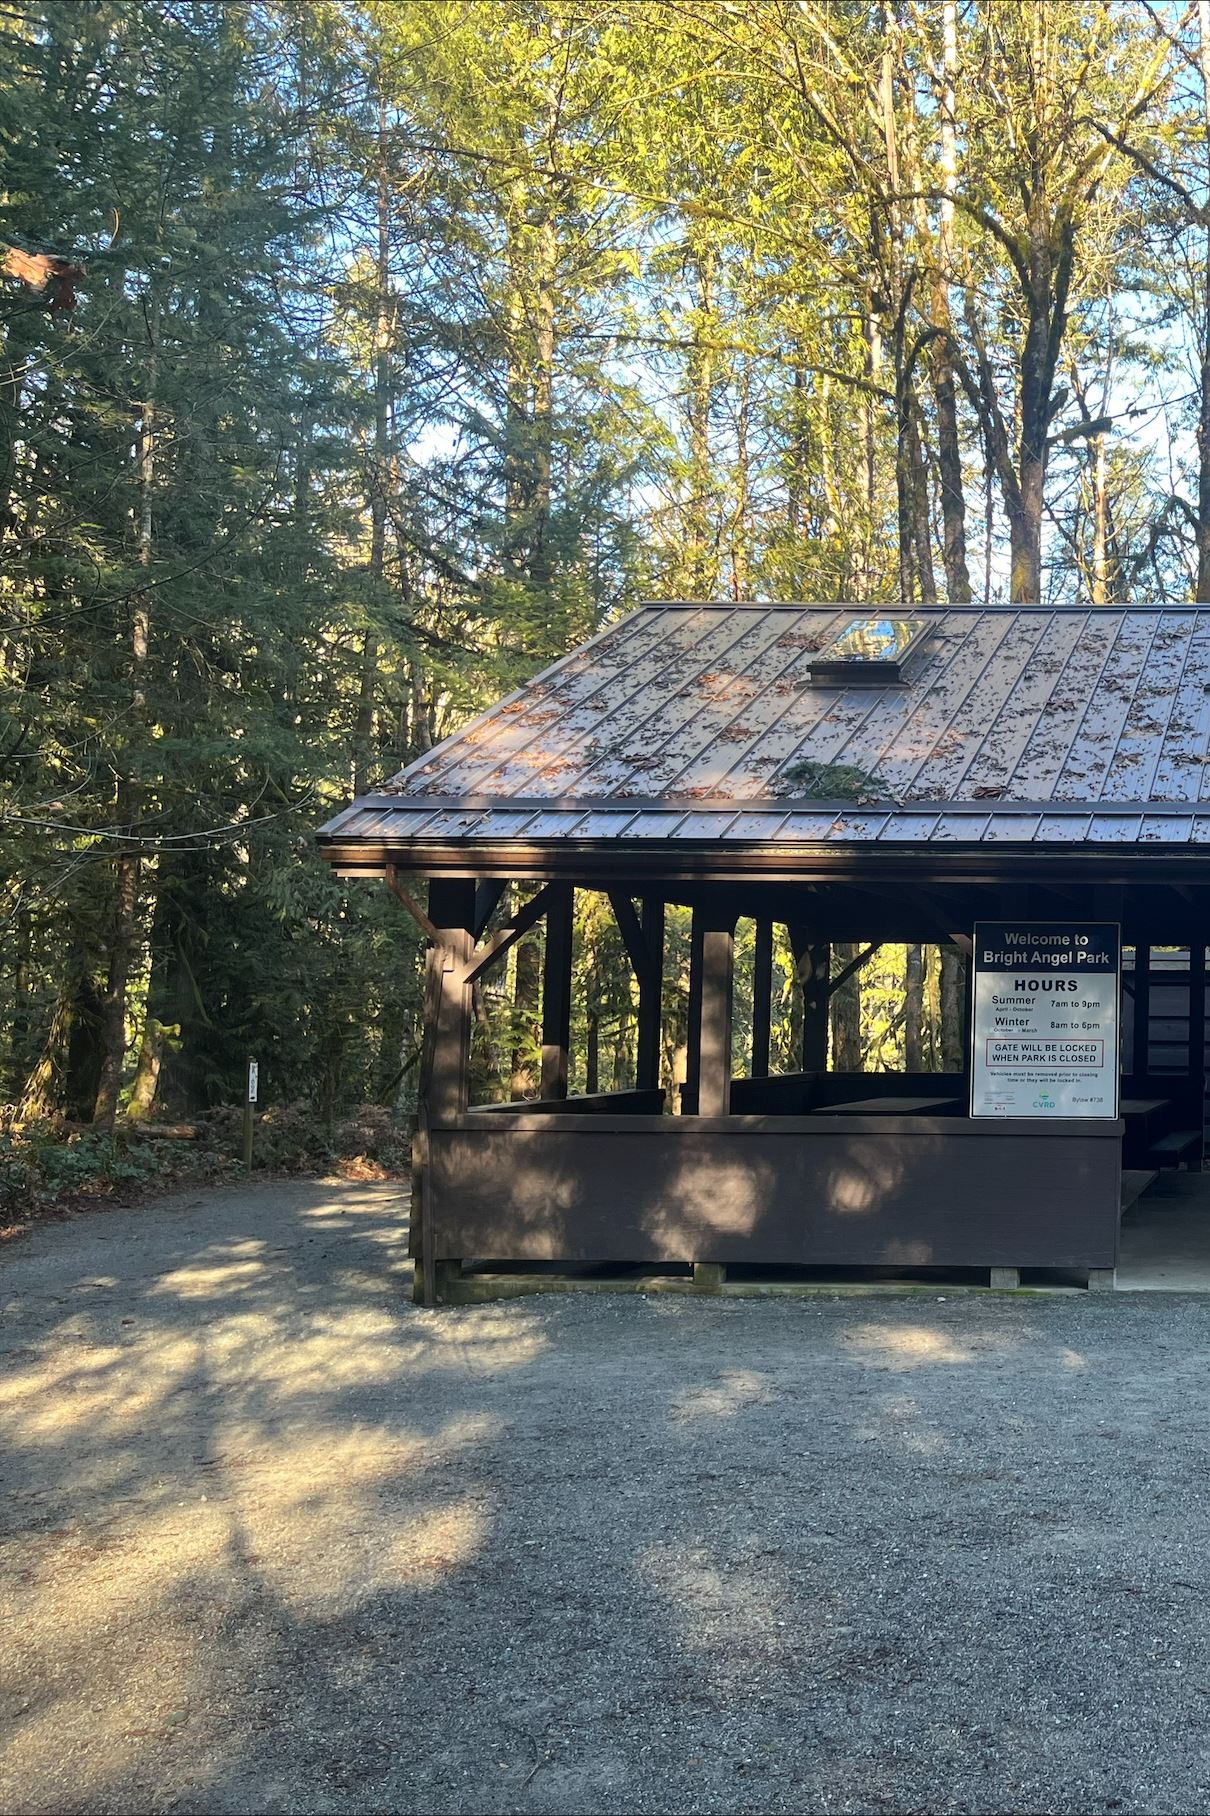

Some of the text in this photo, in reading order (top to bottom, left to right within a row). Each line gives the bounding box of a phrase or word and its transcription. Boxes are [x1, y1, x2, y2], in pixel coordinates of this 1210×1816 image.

[1005, 933, 1089, 946] Welcome to
[983, 950, 1109, 966] Bright Angel Park
[1014, 979, 1079, 991] HOURS
[991, 995, 1036, 1005] Summer
[1050, 1000, 1100, 1009] 7am to 9pm
[995, 1017, 1030, 1026] Winter
[1050, 1021, 1100, 1030] 8am to 6pm
[994, 1043, 1097, 1052] GATE WILL BE LOCKED
[992, 1054, 1096, 1062] WHEN PARK IS CLOSED
[1032, 1101, 1056, 1109] CVRD
